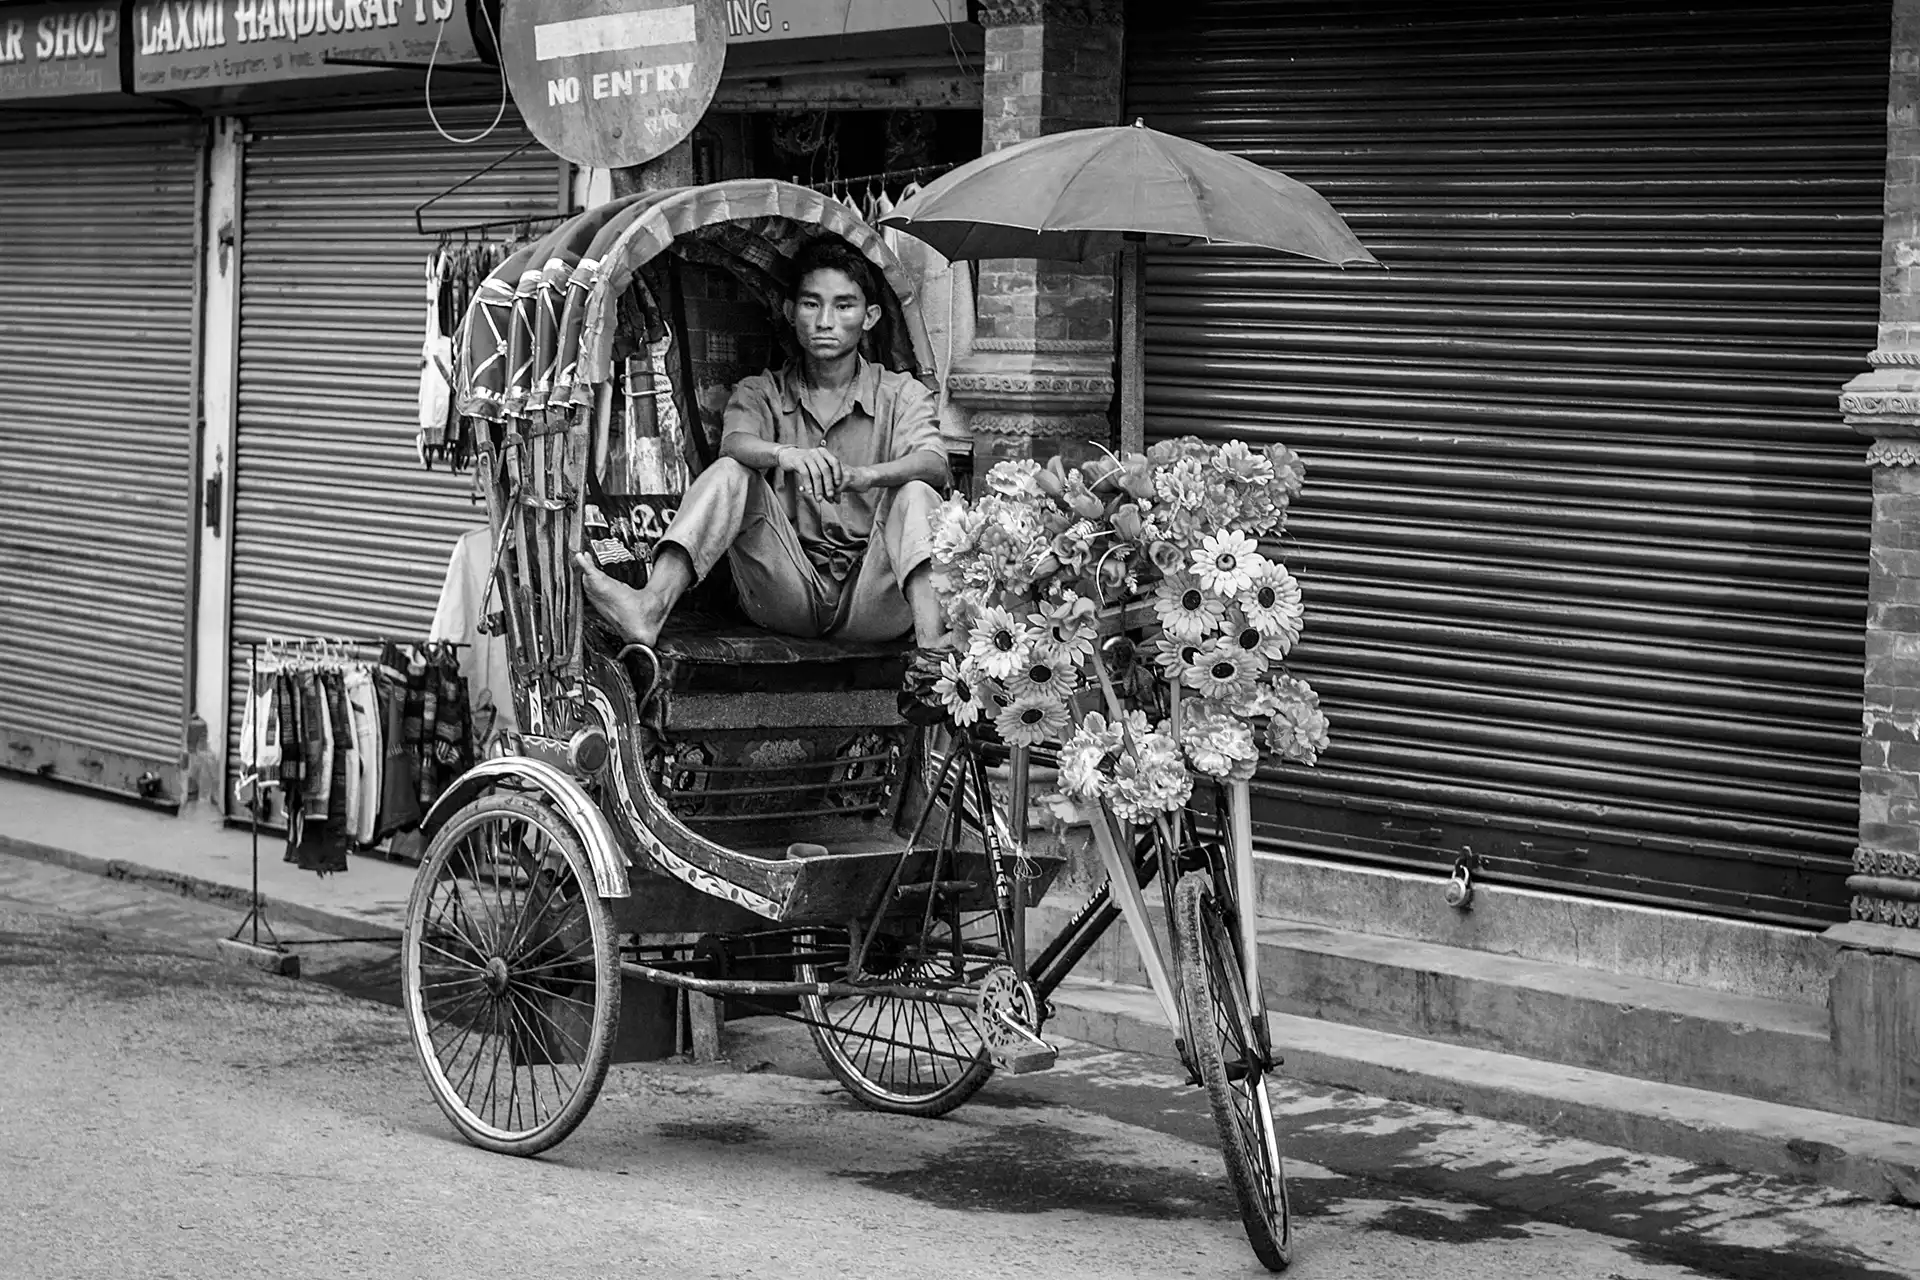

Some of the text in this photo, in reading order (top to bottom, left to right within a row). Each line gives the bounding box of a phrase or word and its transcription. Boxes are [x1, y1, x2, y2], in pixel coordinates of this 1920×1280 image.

[36, 8, 117, 58] SHOP
[141, 1, 225, 55] LAXMI
[547, 62, 694, 107] NO ENTRY
[987, 825, 1010, 897] NEELAM
